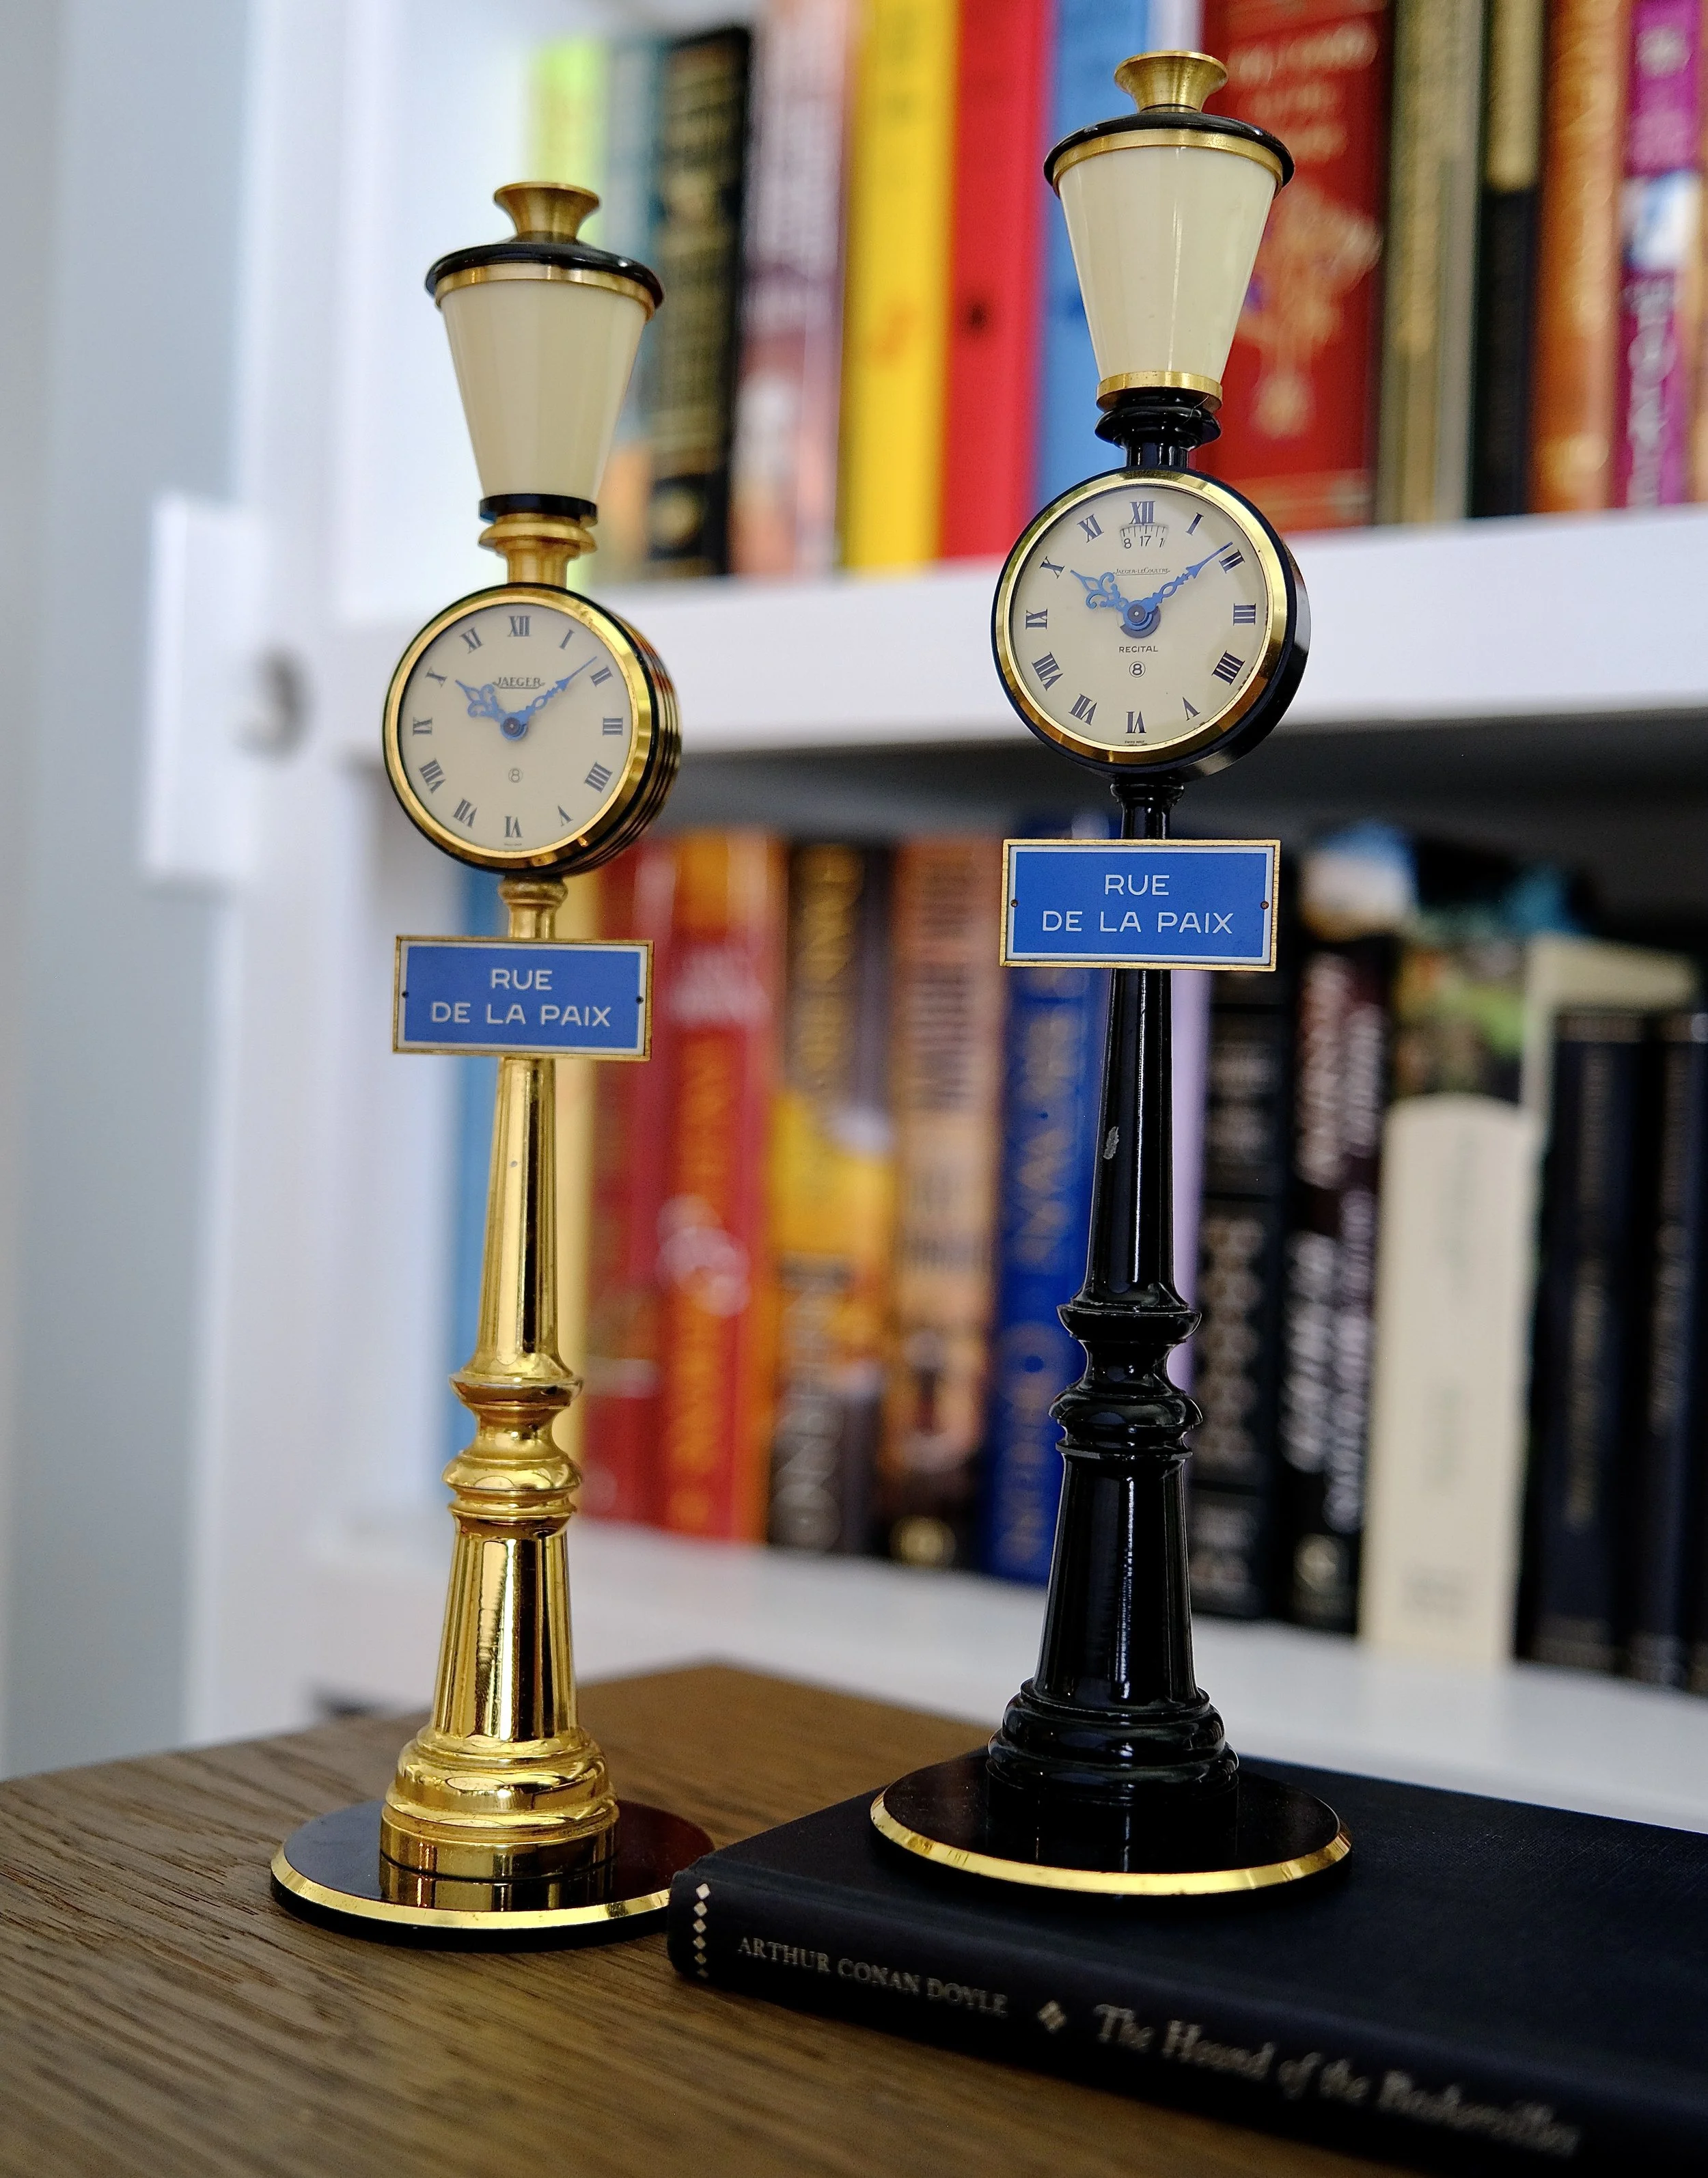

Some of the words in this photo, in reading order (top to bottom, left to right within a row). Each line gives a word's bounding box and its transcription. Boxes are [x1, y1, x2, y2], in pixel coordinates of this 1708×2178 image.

[1129, 501, 1156, 525] XII
[1185, 512, 1204, 536] I
[1077, 514, 1104, 543] XI
[1123, 538, 1132, 549] 8
[1140, 535, 1152, 547] 17
[1039, 556, 1064, 579] X
[1218, 549, 1245, 574] II
[1025, 608, 1048, 629] IX
[1232, 603, 1257, 625] III
[508, 616, 531, 637] XII
[459, 627, 484, 654] XI
[558, 629, 575, 650] I
[425, 667, 448, 688] X
[590, 666, 614, 687] II
[1031, 652, 1064, 691] VIII
[1131, 662, 1144, 676] 8
[1211, 650, 1245, 685] IIII
[495, 677, 542, 687] JAEGER
[1068, 693, 1098, 726] VII
[1183, 697, 1200, 721] V
[412, 717, 433, 736] IX
[602, 717, 624, 736] III
[1125, 711, 1147, 734] VI
[418, 758, 446, 794] VIII
[510, 769, 521, 782] 8
[583, 762, 613, 793] IIII
[452, 798, 478, 828] VII
[557, 805, 574, 827] V
[504, 816, 523, 838] VI
[1104, 874, 1170, 896] RUE
[1042, 910, 1083, 932] DE
[1099, 911, 1142, 933] LA
[1157, 911, 1234, 935] PAIX
[491, 969, 553, 991] RUE
[431, 1002, 471, 1023] DE
[486, 1004, 527, 1025] LA
[540, 1004, 612, 1027] PAIX
[738, 1936, 831, 1974] ARTHUR
[838, 1958, 920, 1996] CONAN
[926, 1978, 1009, 2017] DOYLE
[1094, 2002, 1154, 2052] The
